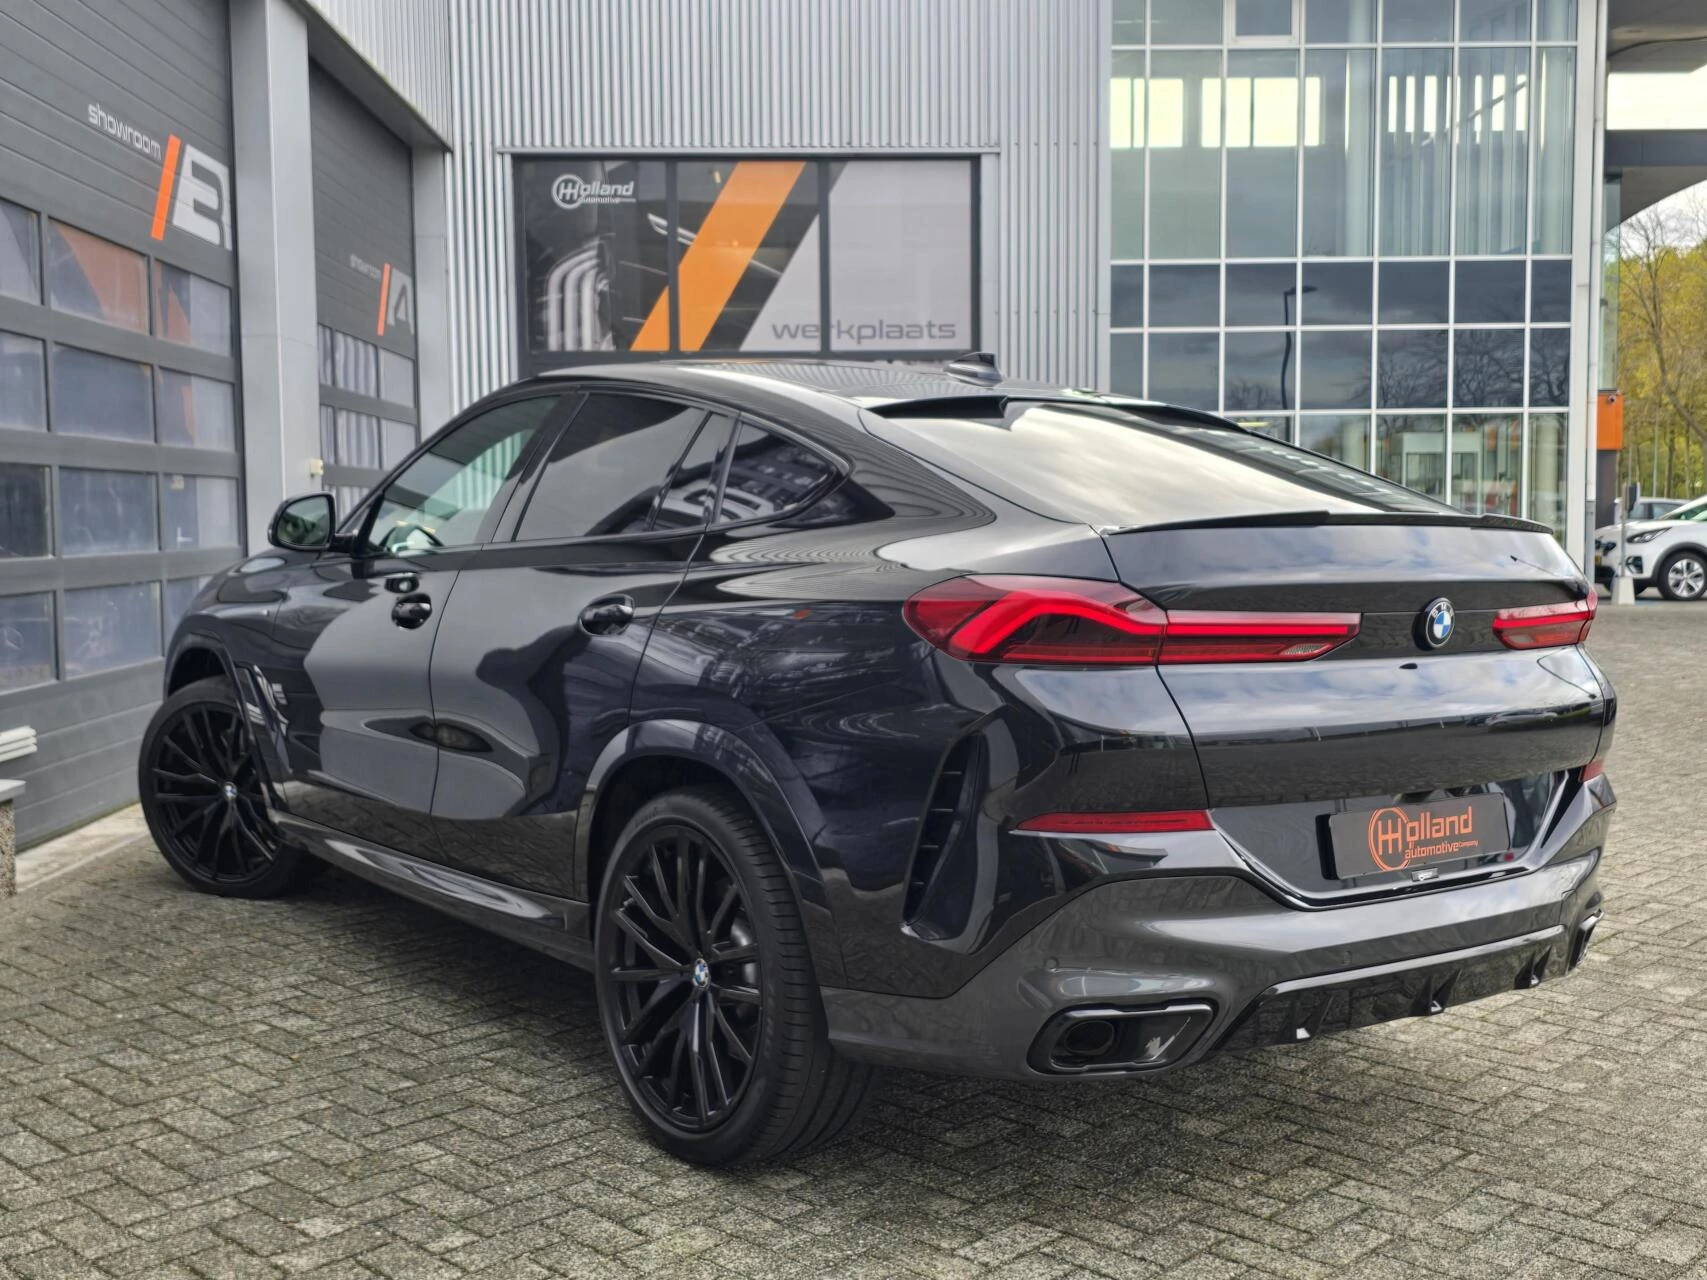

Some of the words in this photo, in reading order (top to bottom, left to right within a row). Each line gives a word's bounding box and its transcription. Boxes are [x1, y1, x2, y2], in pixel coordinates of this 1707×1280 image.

[88, 103, 161, 160] showroom
[172, 143, 233, 251] B
[557, 180, 634, 201] Holland
[772, 319, 956, 344] wekplaats
[1376, 806, 1472, 856] Holland
[1404, 841, 1459, 859] automotive
